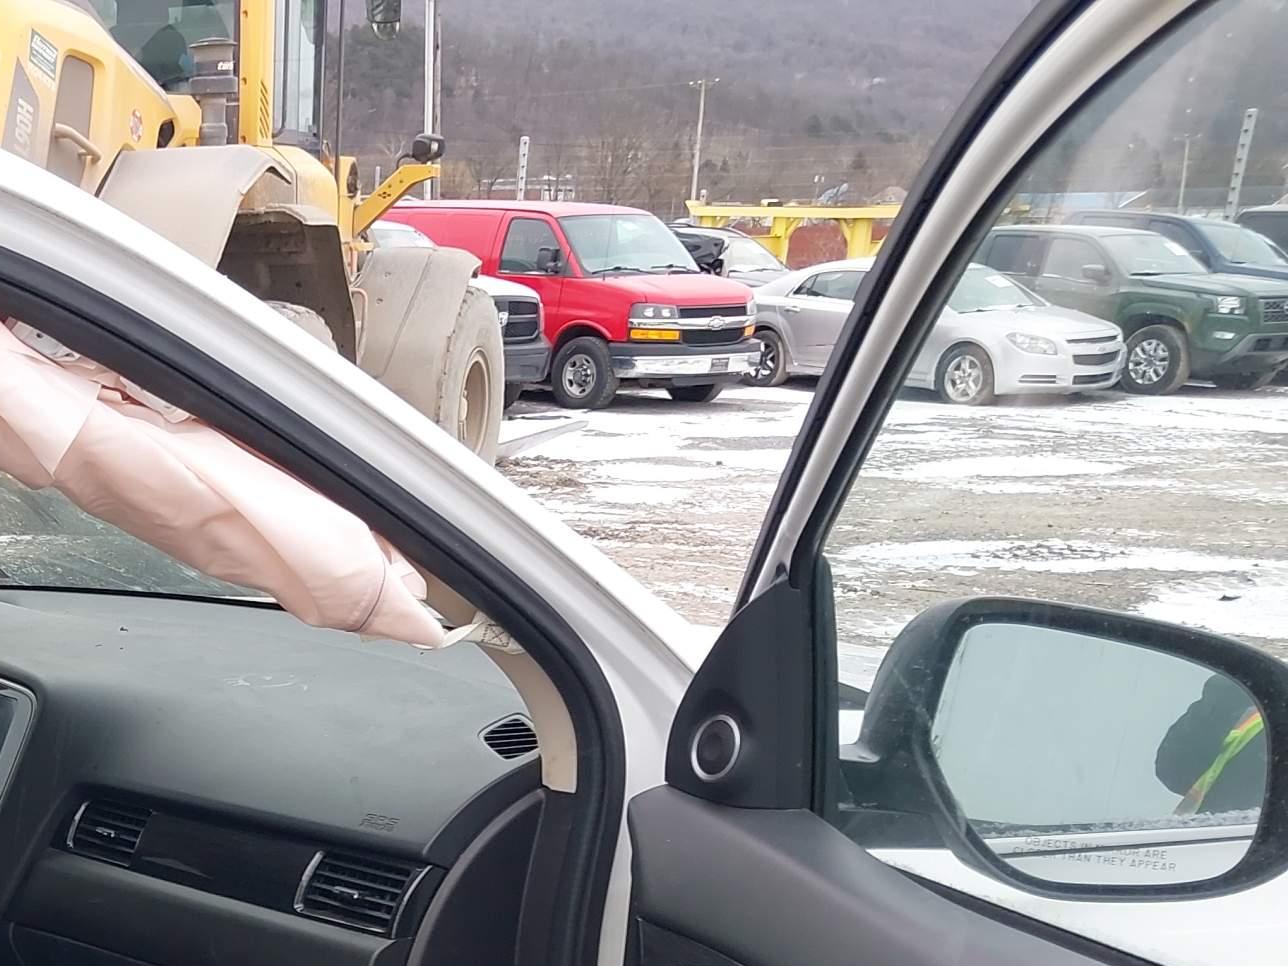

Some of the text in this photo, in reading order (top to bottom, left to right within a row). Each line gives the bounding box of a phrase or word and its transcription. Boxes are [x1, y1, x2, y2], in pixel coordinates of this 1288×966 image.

[1025, 837, 1078, 849] OBJECTS
[1144, 850, 1167, 860] ARE
[1096, 855, 1125, 867] THEY
[1128, 858, 1177, 872] APPEAR
